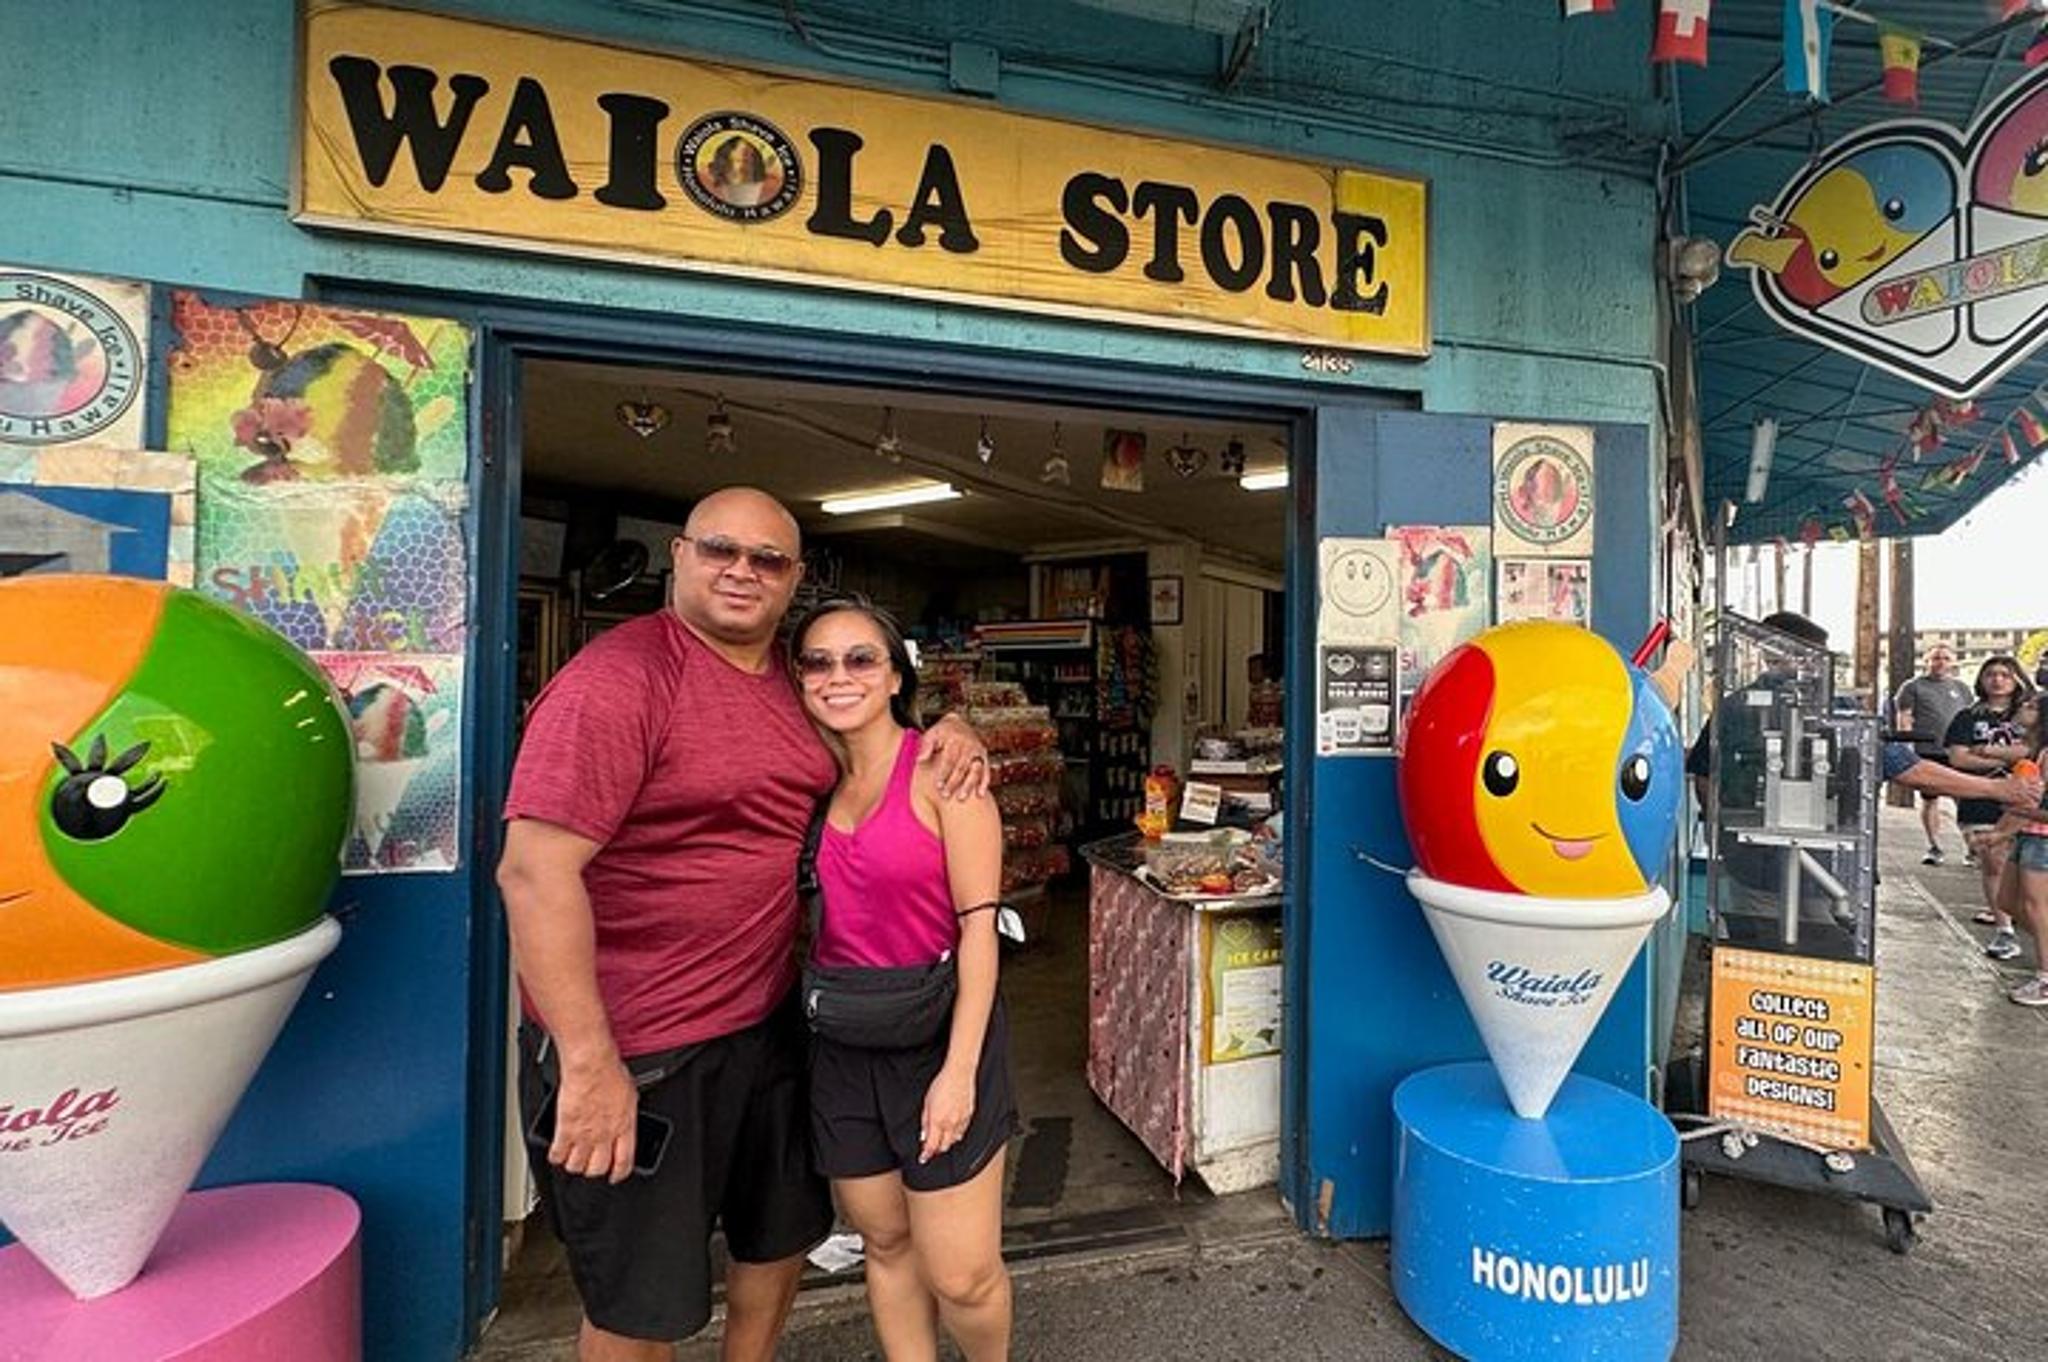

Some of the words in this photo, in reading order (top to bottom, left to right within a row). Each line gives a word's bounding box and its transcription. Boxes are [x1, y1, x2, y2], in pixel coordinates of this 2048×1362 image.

[1059, 171, 1390, 316] STORE
[16, 283, 95, 321] Shave
[99, 326, 124, 357] Ice
[1488, 960, 1603, 993] Waiola
[1496, 987, 1558, 1007] Shave
[1774, 1022, 1799, 1045] OF
[40, 1116, 109, 1147] Ice
[1472, 1246, 1649, 1305] HONOLULU
